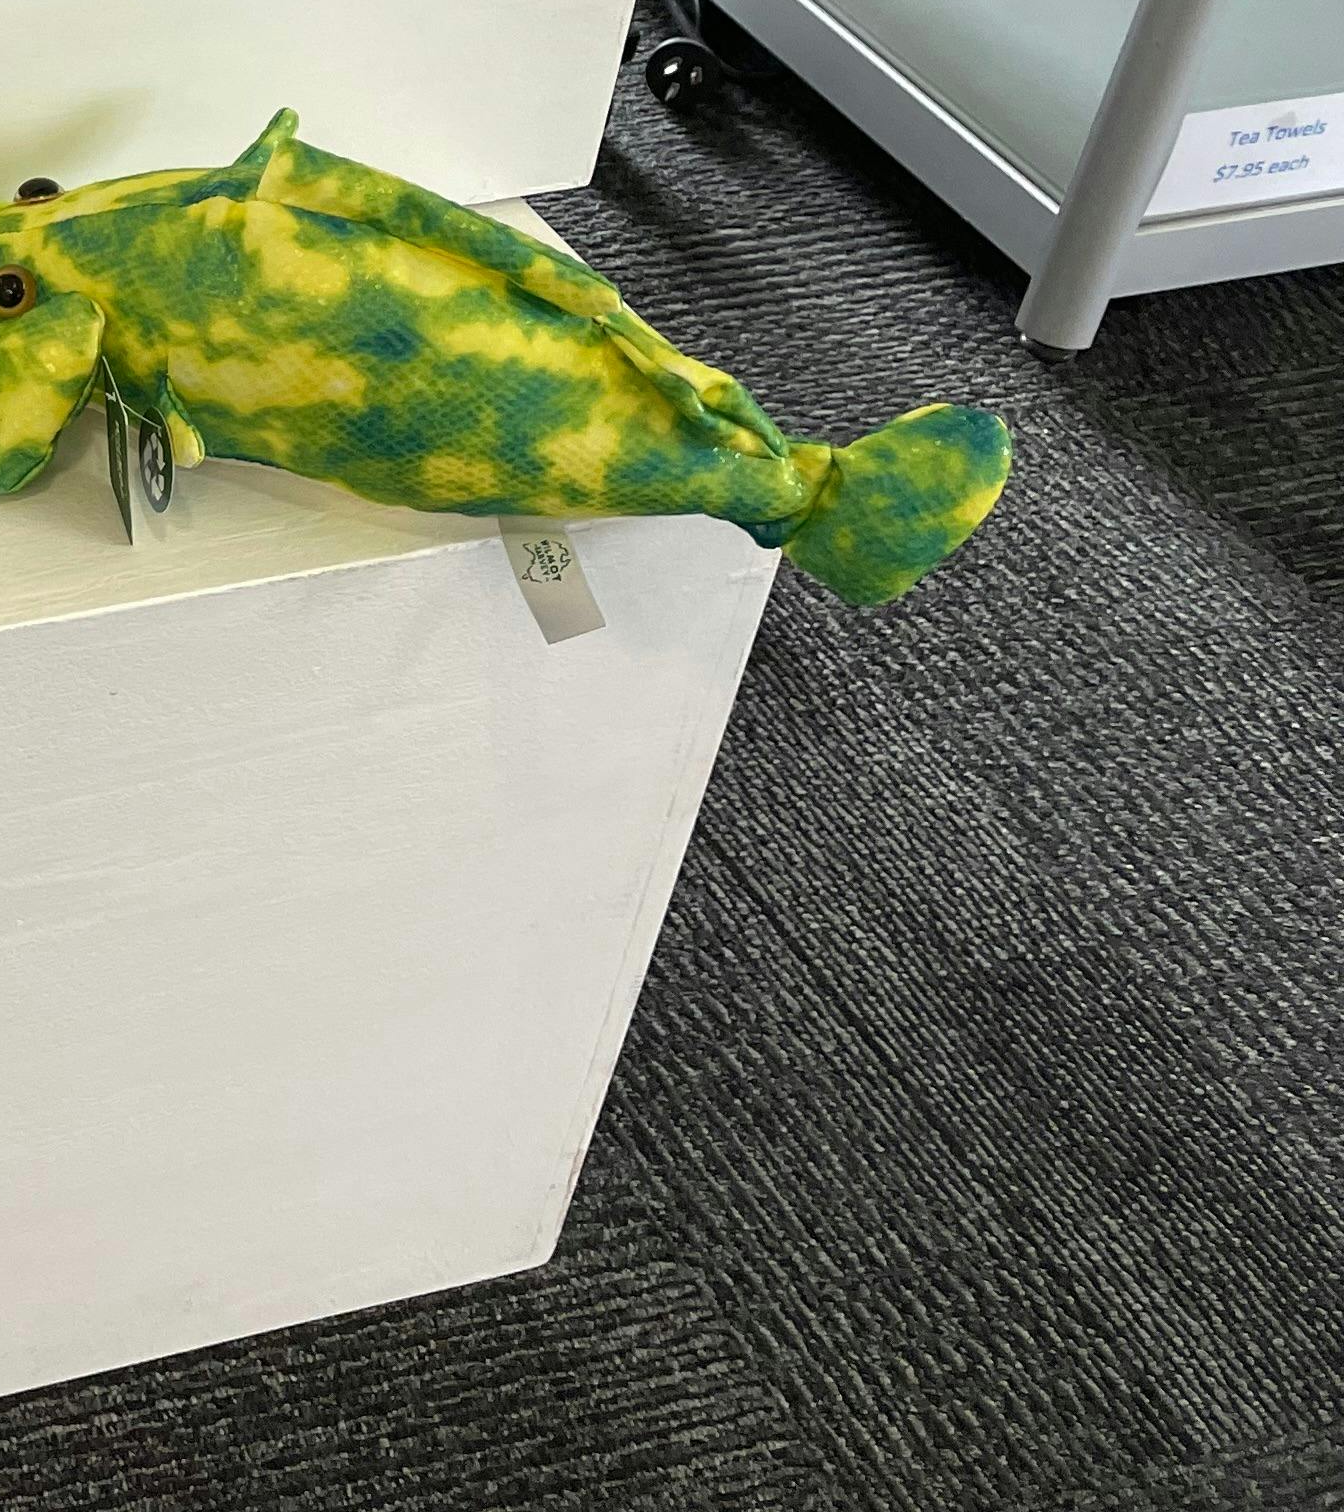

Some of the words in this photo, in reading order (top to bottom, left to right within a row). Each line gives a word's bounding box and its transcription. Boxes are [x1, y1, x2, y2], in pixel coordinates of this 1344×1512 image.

[1229, 129, 1260, 148] Tea
[1266, 119, 1328, 141] Towels
[1213, 160, 1264, 183] $7.95
[1268, 155, 1310, 175] each
